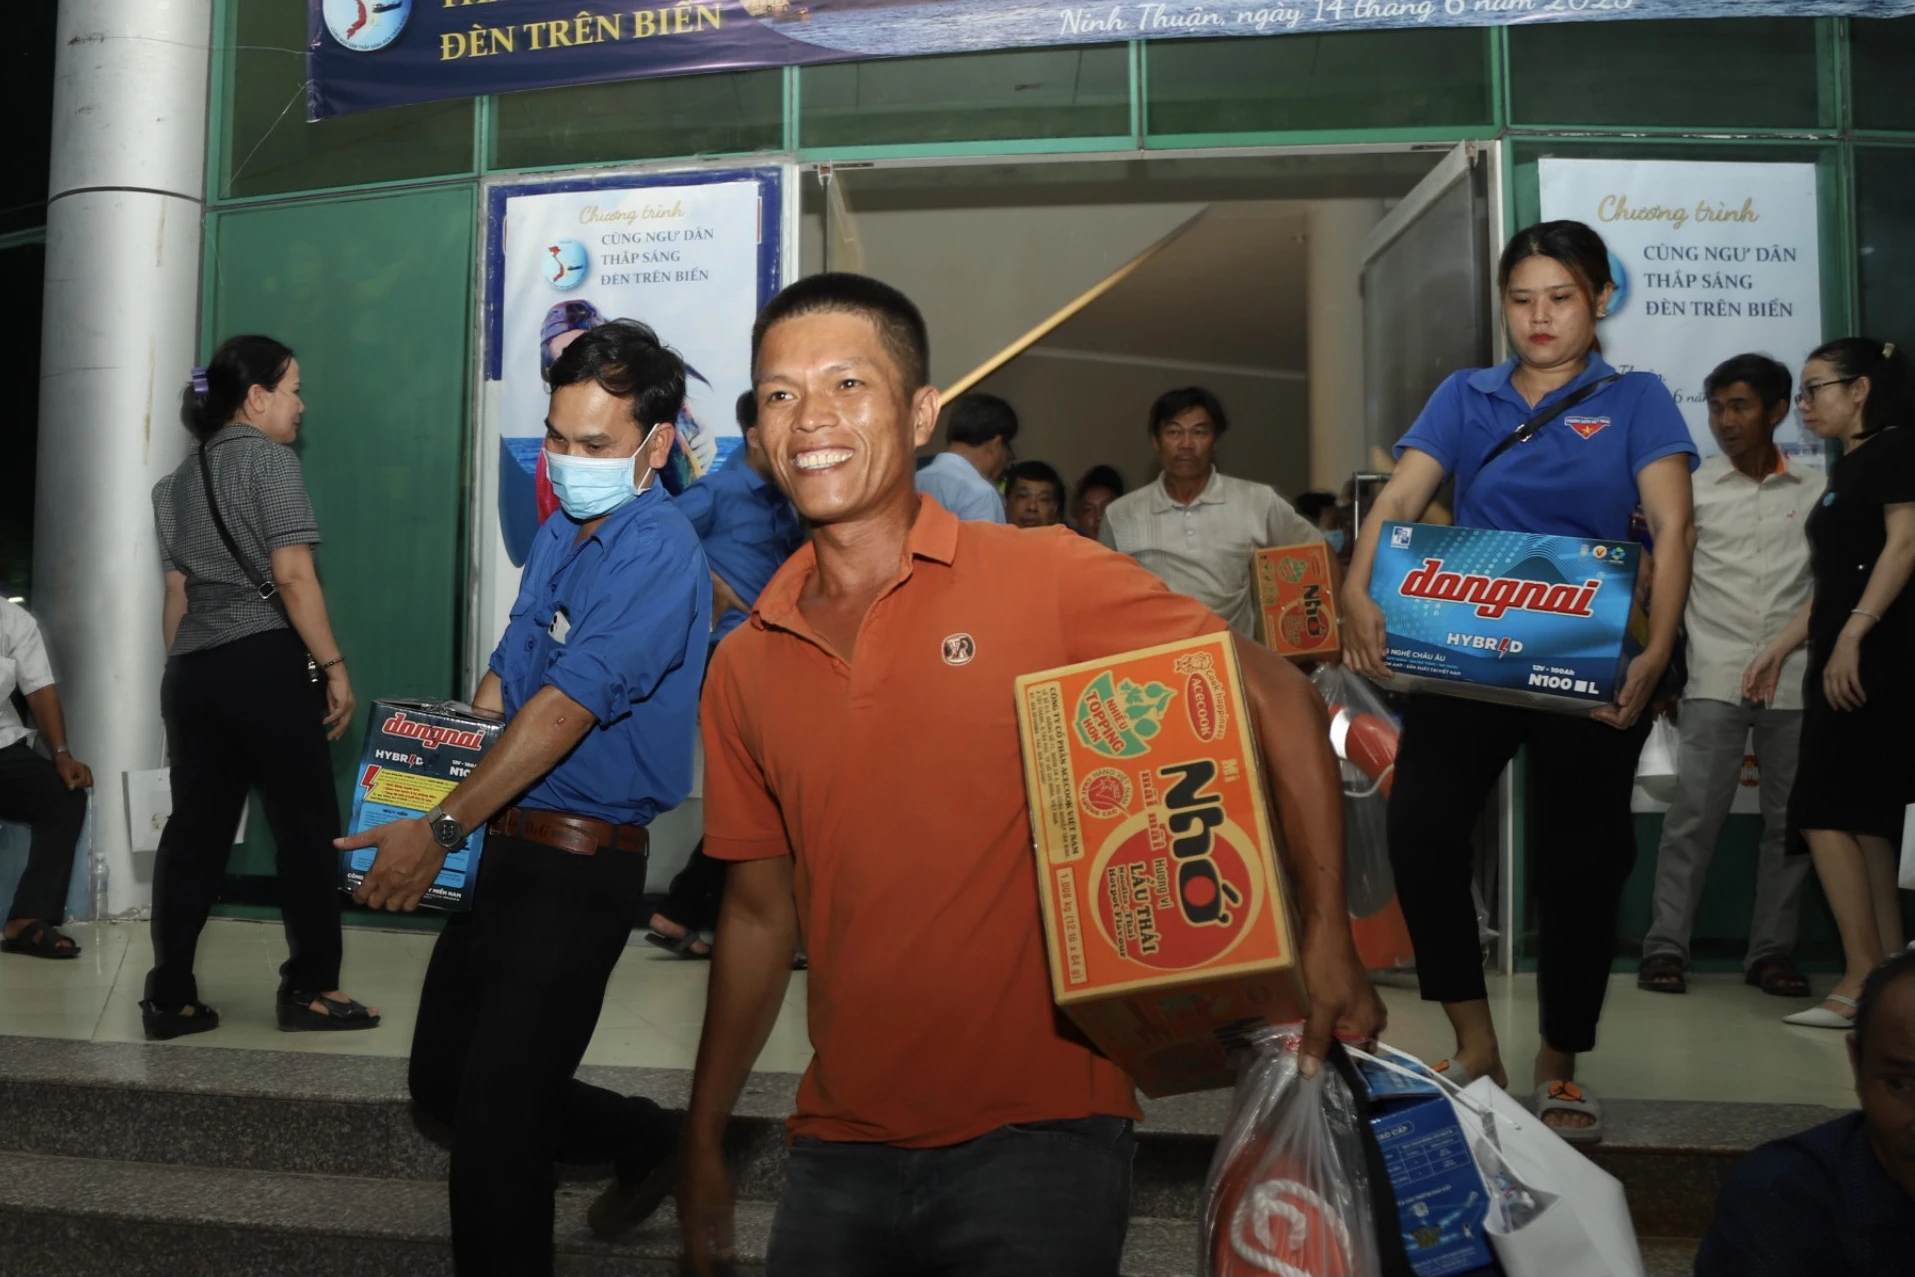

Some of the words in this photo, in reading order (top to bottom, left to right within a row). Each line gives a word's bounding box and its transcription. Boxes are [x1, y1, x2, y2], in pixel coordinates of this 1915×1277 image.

[1060, 5, 1125, 37] Ninh
[1238, 2, 1300, 30] ngày
[1311, 0, 1345, 22] 14
[440, 23, 515, 61] ĐÈN
[523, 10, 622, 51] TRÊN
[578, 205, 638, 226] Chương
[640, 200, 686, 221] trình
[1597, 195, 1689, 229] Chương
[1694, 197, 1759, 223] trình
[601, 230, 642, 246] CÙNG
[645, 230, 682, 244] NGƯ
[683, 226, 715, 242] DÂN
[642, 248, 681, 264] SÁNG
[1643, 243, 1699, 262] CÙNG
[1704, 247, 1750, 263] NGƯ
[1756, 244, 1797, 262] DÂN
[600, 271, 630, 286] ĐÈN
[632, 269, 672, 285] TRÊN
[1644, 269, 1697, 289] THẮP
[1702, 268, 1753, 290] SÁNG
[1645, 297, 1687, 317] ĐÈN
[1690, 298, 1741, 317] TRÊN
[1748, 296, 1793, 318] BIỂN
[1400, 558, 1603, 620] dongnai
[1206, 667, 1223, 691] Cook
[1528, 673, 1573, 690] N100
[1532, 664, 1546, 672] 12V
[1551, 666, 1575, 676] 100Ah
[1049, 686, 1060, 711] CÔNG
[1053, 713, 1061, 724] TY
[1085, 690, 1124, 753] TOPPING
[1105, 699, 1130, 730] NHIỀU
[381, 711, 487, 750] dongnai
[1082, 718, 1101, 743] HƠN
[1060, 767, 1073, 808] ACECOOK
[1066, 810, 1077, 832] VIỆT
[1070, 833, 1079, 854] NAM
[1159, 758, 1242, 931] Nhớ
[1129, 861, 1157, 901] LẨU
[1152, 858, 1170, 894] Hương
[1062, 900, 1073, 912] kg
[1105, 868, 1120, 908] Hotpot
[1113, 911, 1128, 958] Flavour
[1117, 866, 1130, 904] Noodles
[1124, 911, 1135, 938] Thai
[1158, 896, 1172, 908] vị
[1136, 904, 1160, 953] THÁI
